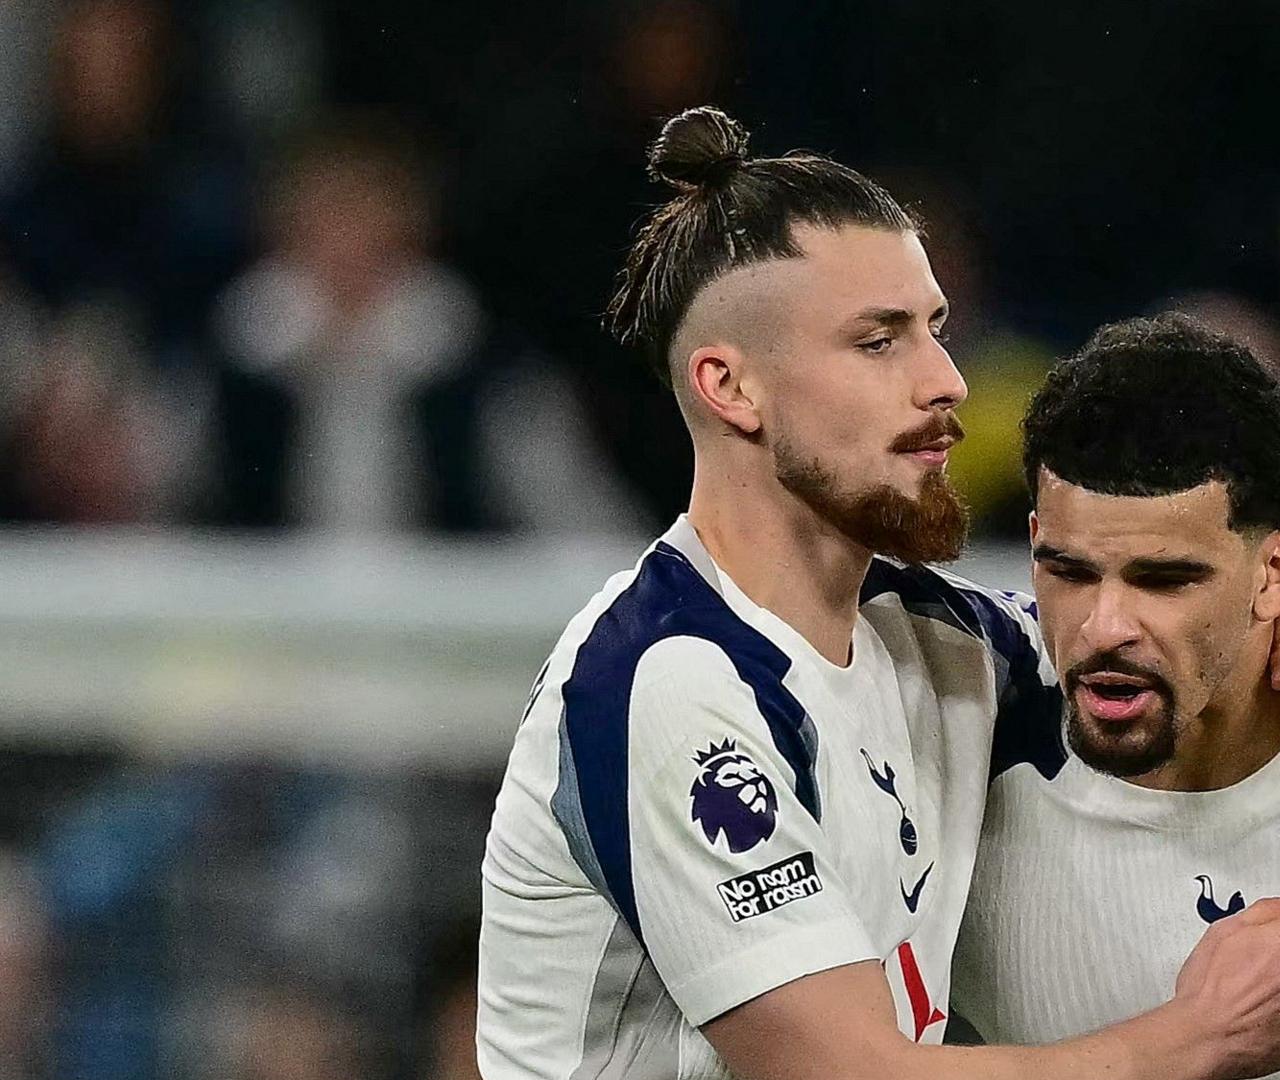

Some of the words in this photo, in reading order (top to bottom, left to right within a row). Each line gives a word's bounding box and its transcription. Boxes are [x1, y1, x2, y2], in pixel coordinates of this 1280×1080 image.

[718, 879, 756, 905] No
[756, 860, 806, 892] room
[728, 896, 760, 921] for
[762, 874, 822, 910] racsm
